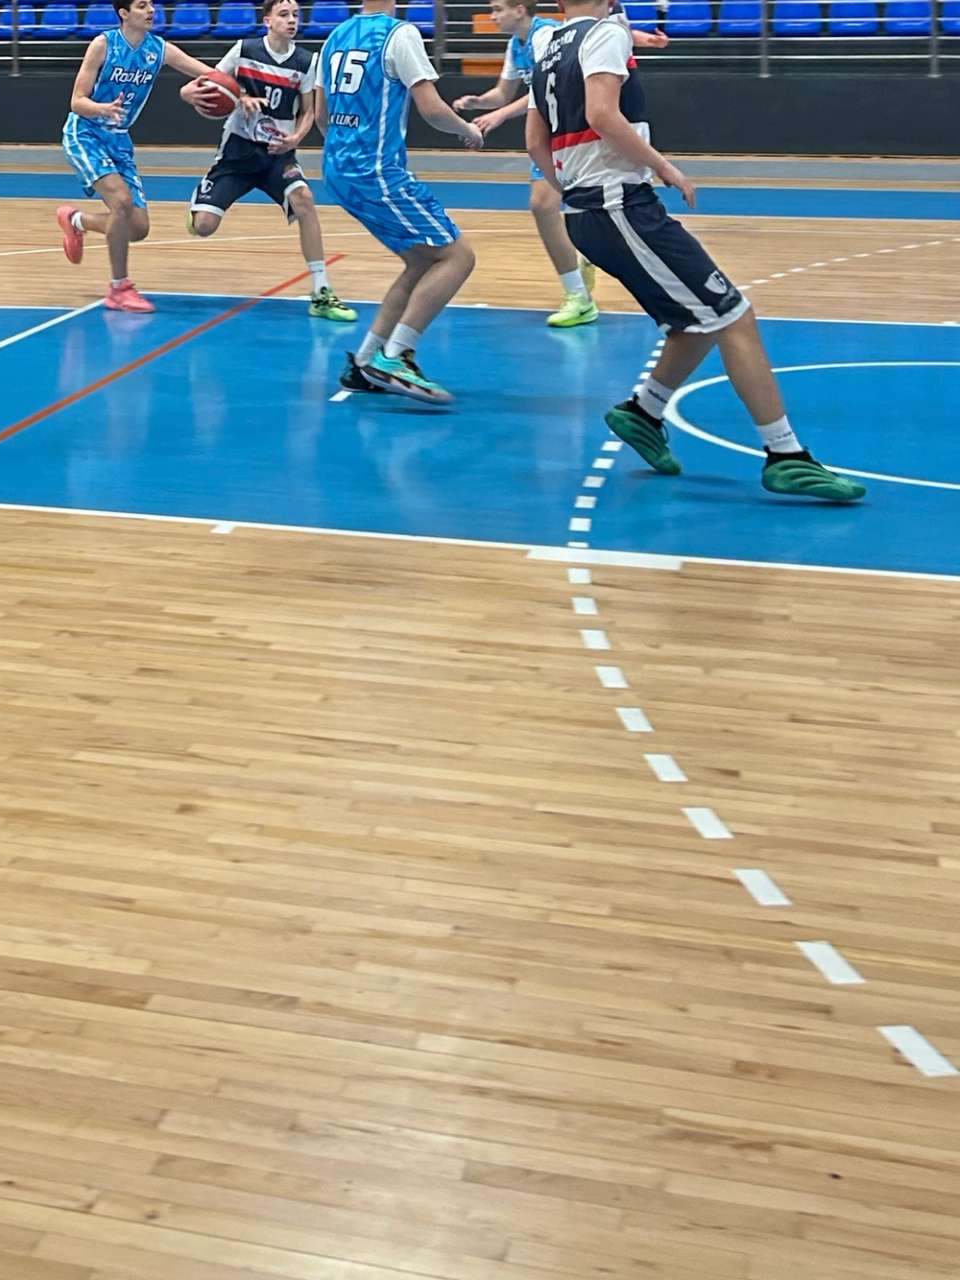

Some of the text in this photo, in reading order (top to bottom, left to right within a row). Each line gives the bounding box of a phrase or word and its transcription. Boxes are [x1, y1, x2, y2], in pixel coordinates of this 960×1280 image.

[109, 66, 153, 85] Rookie
[329, 49, 370, 95] 15
[123, 92, 136, 105] 2
[264, 85, 283, 111] 10
